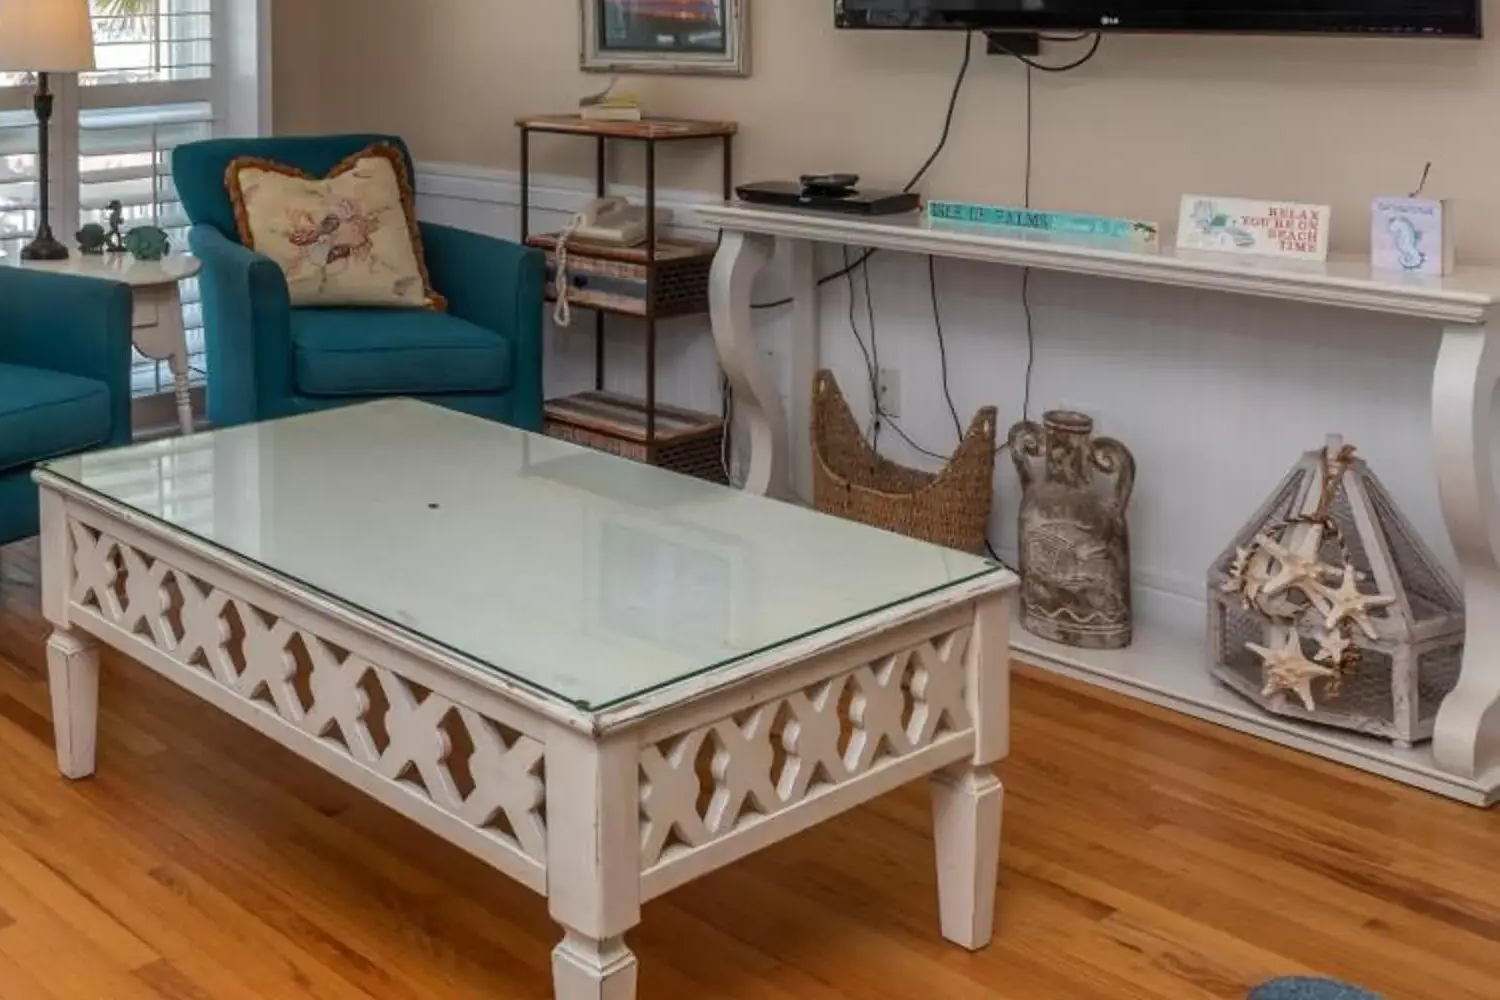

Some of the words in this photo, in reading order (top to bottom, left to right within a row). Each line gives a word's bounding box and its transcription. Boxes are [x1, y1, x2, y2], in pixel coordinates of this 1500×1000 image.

[995, 208, 1053, 230] PALMS
[1268, 206, 1319, 220] RELAX
[1298, 219, 1319, 231] ON
[1268, 228, 1318, 242] BEACH
[1280, 240, 1317, 252] TIME
